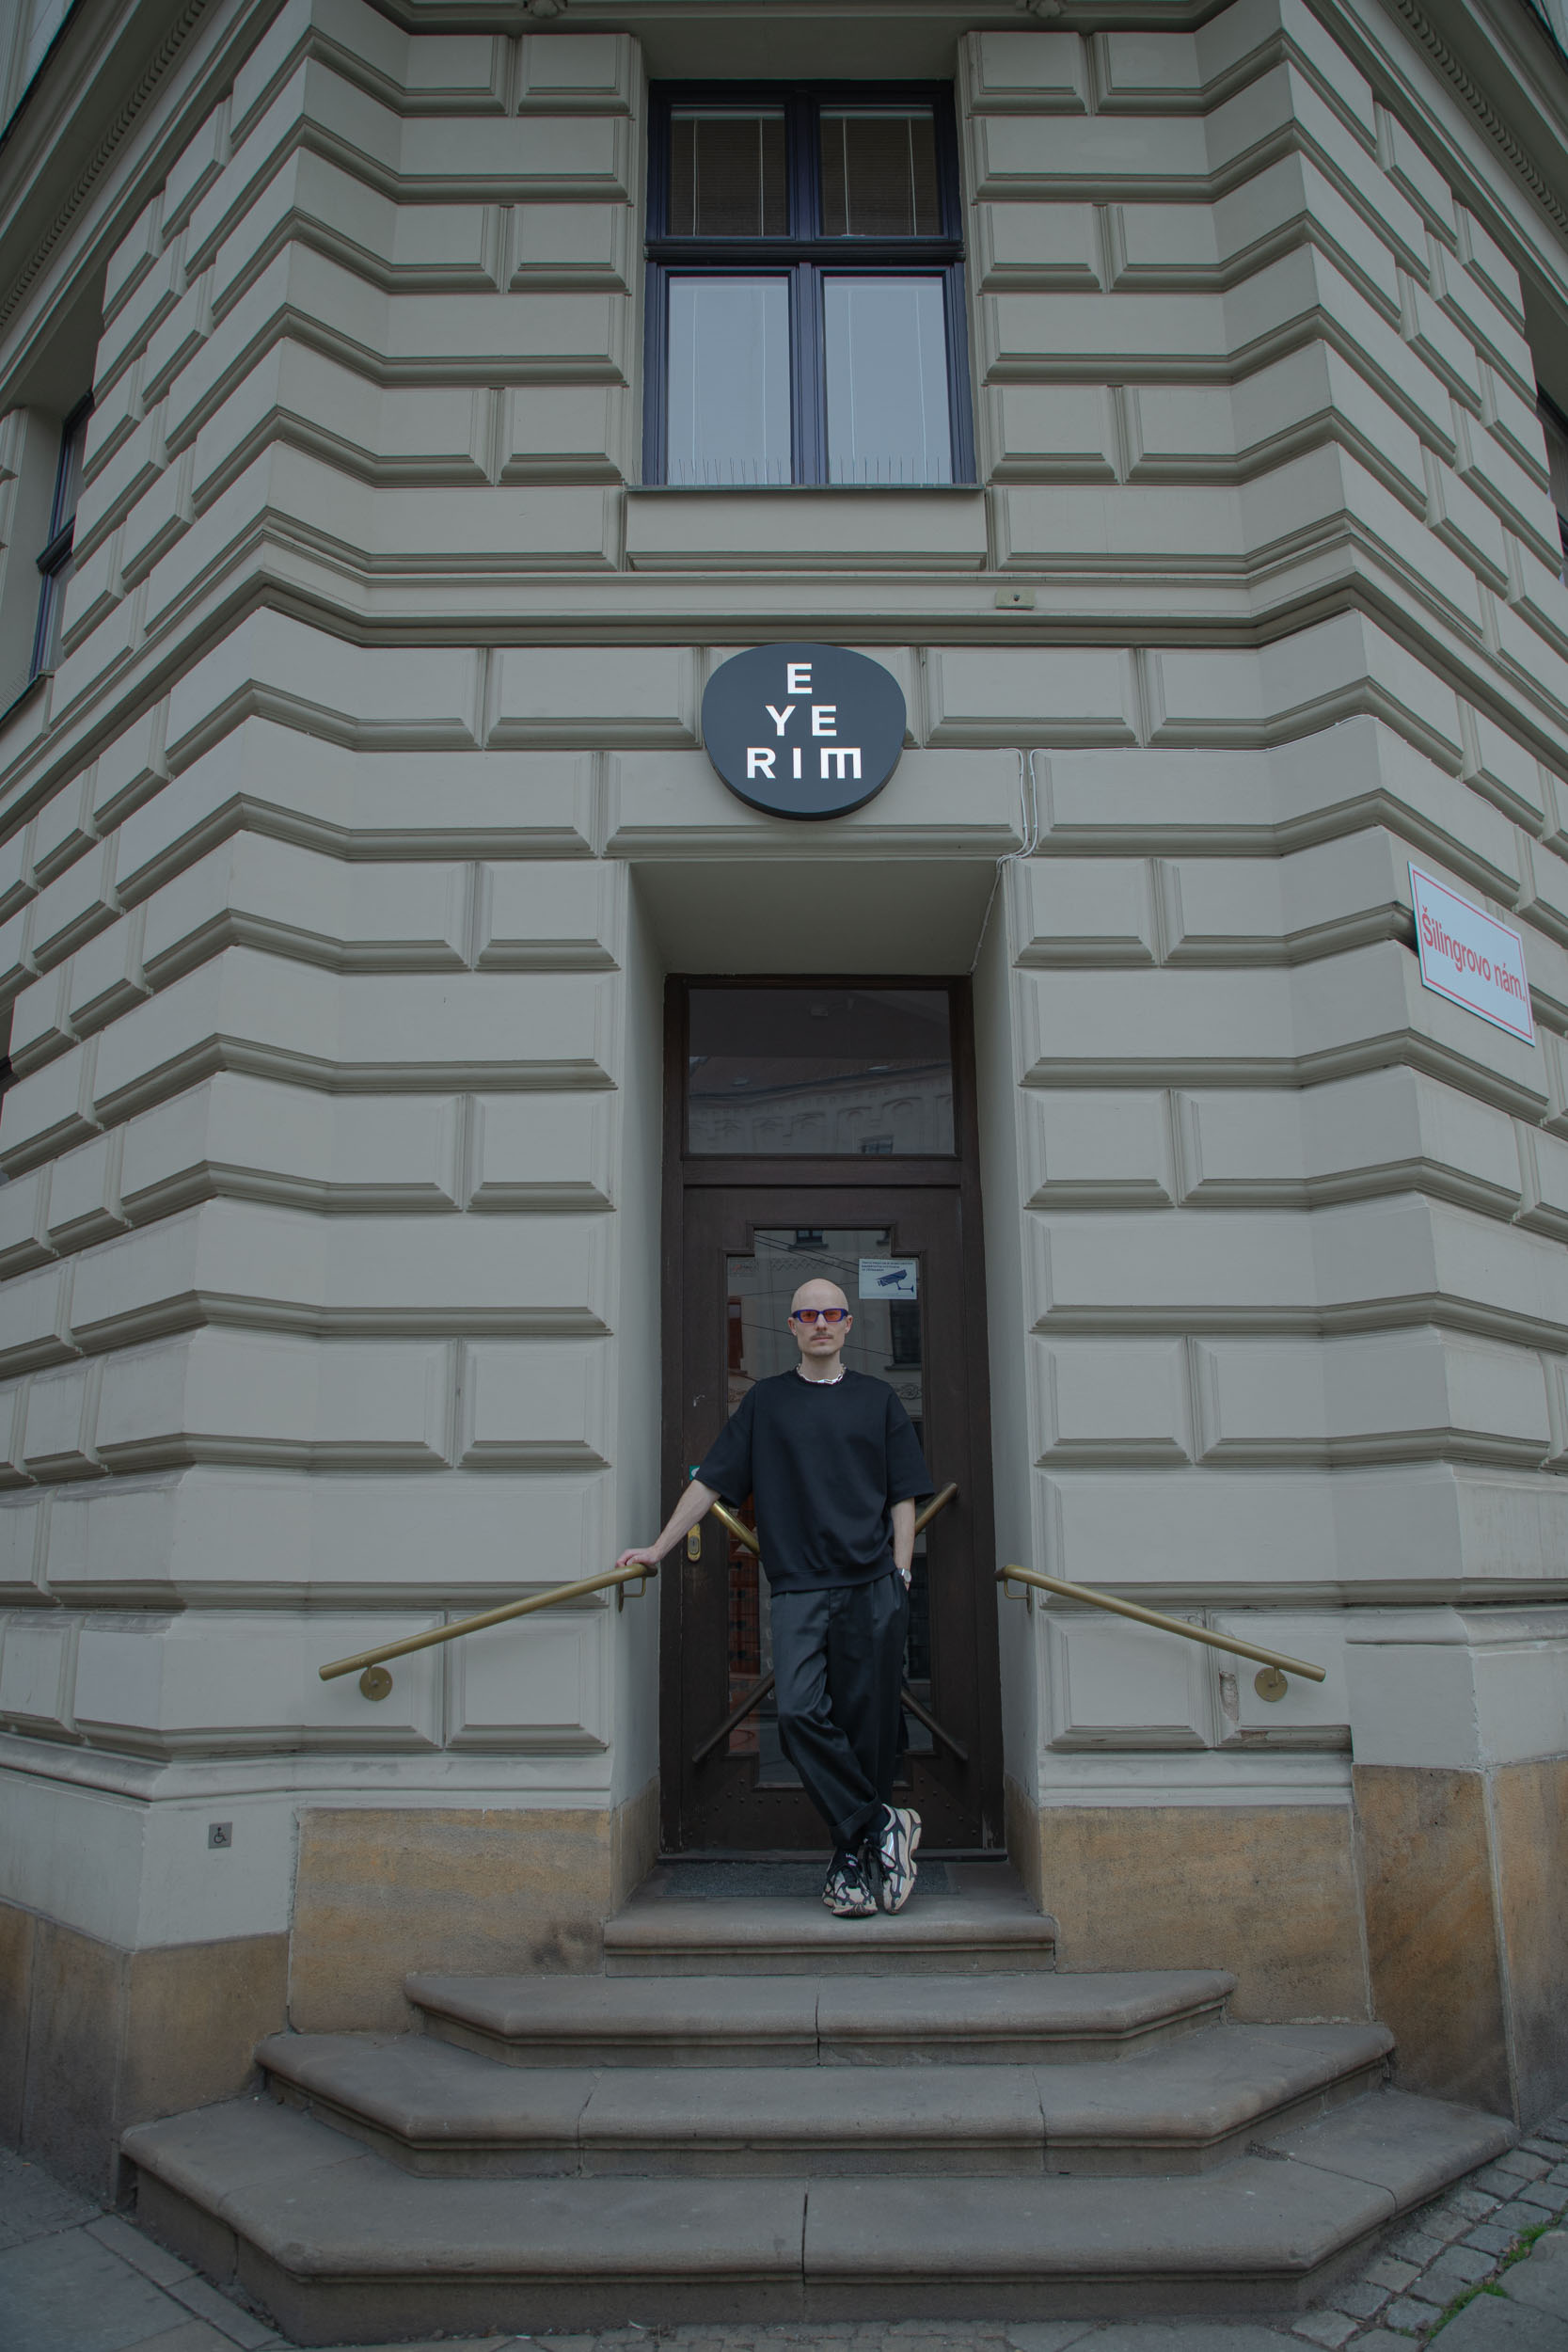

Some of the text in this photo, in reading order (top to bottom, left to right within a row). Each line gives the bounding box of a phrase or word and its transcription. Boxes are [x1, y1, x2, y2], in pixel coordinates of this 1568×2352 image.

[786, 662, 813, 694] E
[1421, 905, 1527, 1002] Šilingrovo nám.
